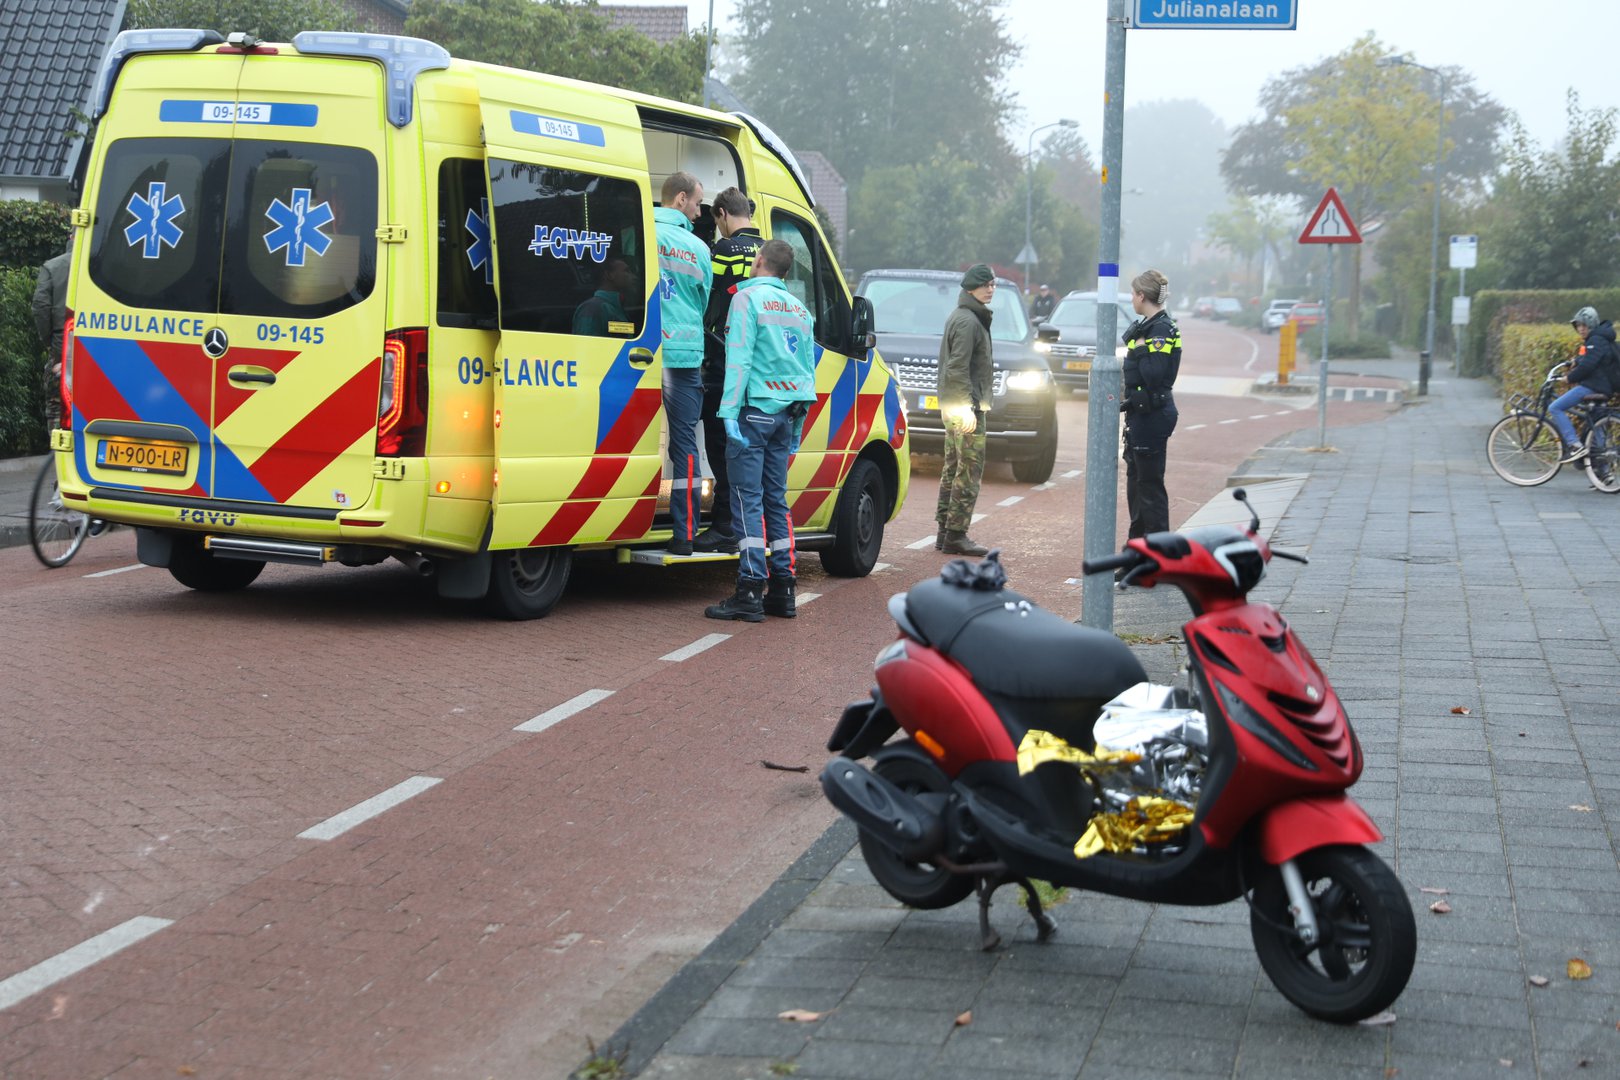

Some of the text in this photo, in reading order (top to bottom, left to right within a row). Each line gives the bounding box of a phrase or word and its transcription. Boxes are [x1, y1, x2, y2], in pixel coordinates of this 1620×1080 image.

[1152, 0, 1278, 18] Julianalaan
[213, 105, 260, 119] 09-145
[545, 121, 573, 137] 09-145
[658, 245, 697, 264] ULANCE
[763, 301, 807, 320] AMBULANCE
[76, 312, 204, 337] AMBULANCE
[257, 323, 324, 344] 09-145
[458, 356, 491, 385] 09-
[504, 358, 578, 387] LANCE
[109, 445, 182, 467] N-900-LR
